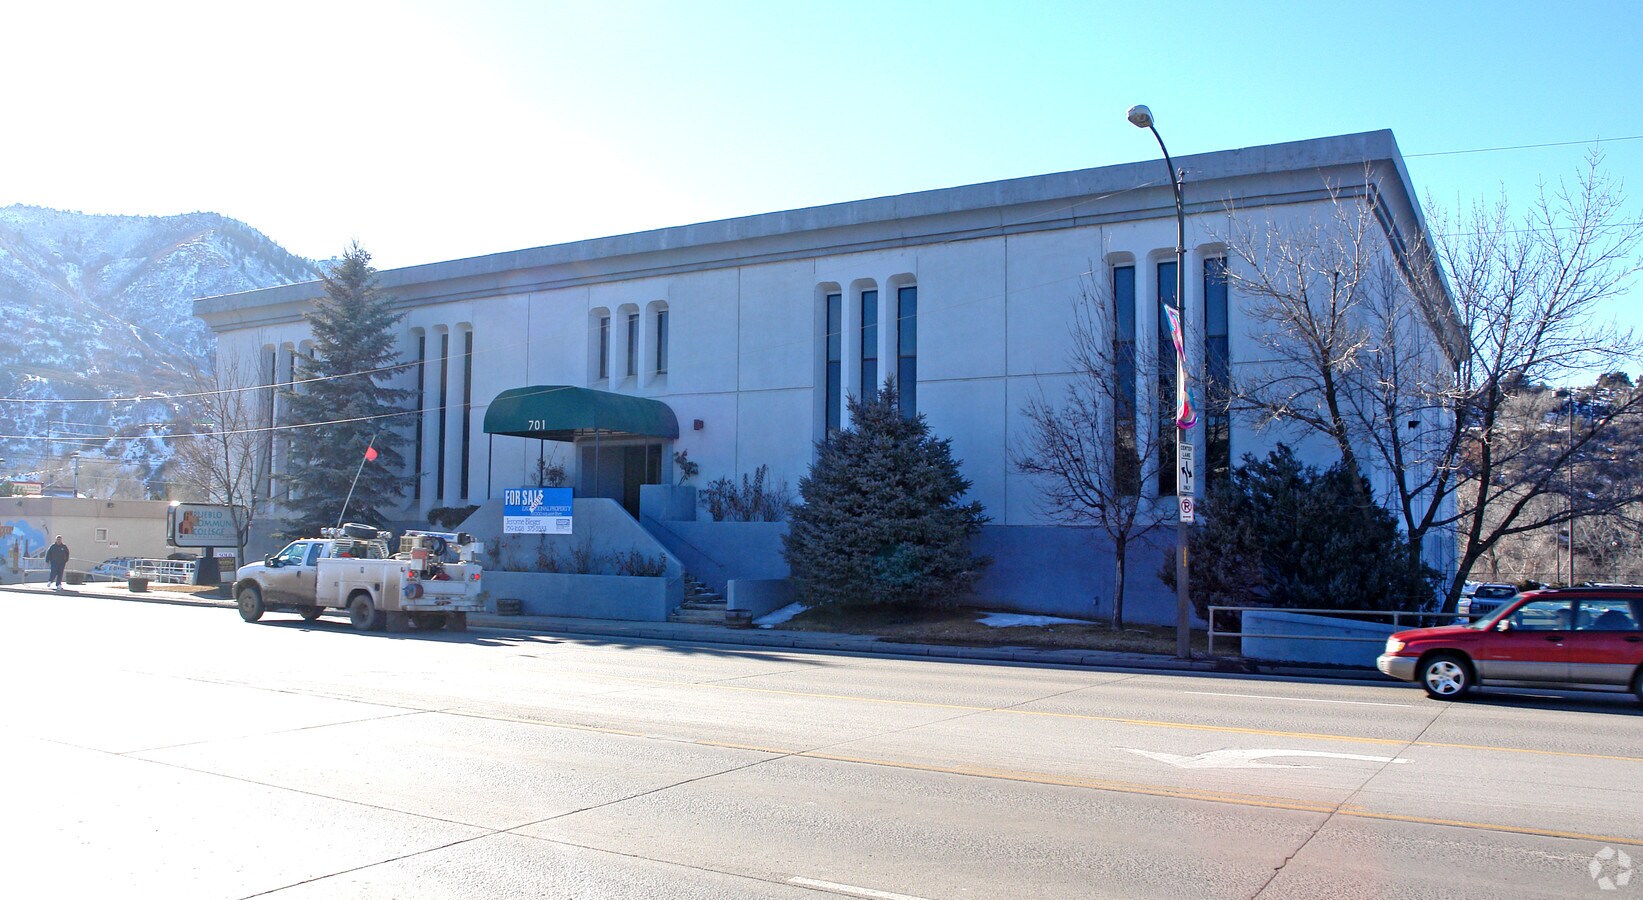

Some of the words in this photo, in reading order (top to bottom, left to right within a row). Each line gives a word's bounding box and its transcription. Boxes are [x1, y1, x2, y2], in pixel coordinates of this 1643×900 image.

[528, 419, 545, 430] 701
[505, 490, 520, 506] FOR
[522, 490, 543, 506] SALE
[194, 511, 222, 519] PUEBLO
[193, 528, 224, 536] COLLEGE
